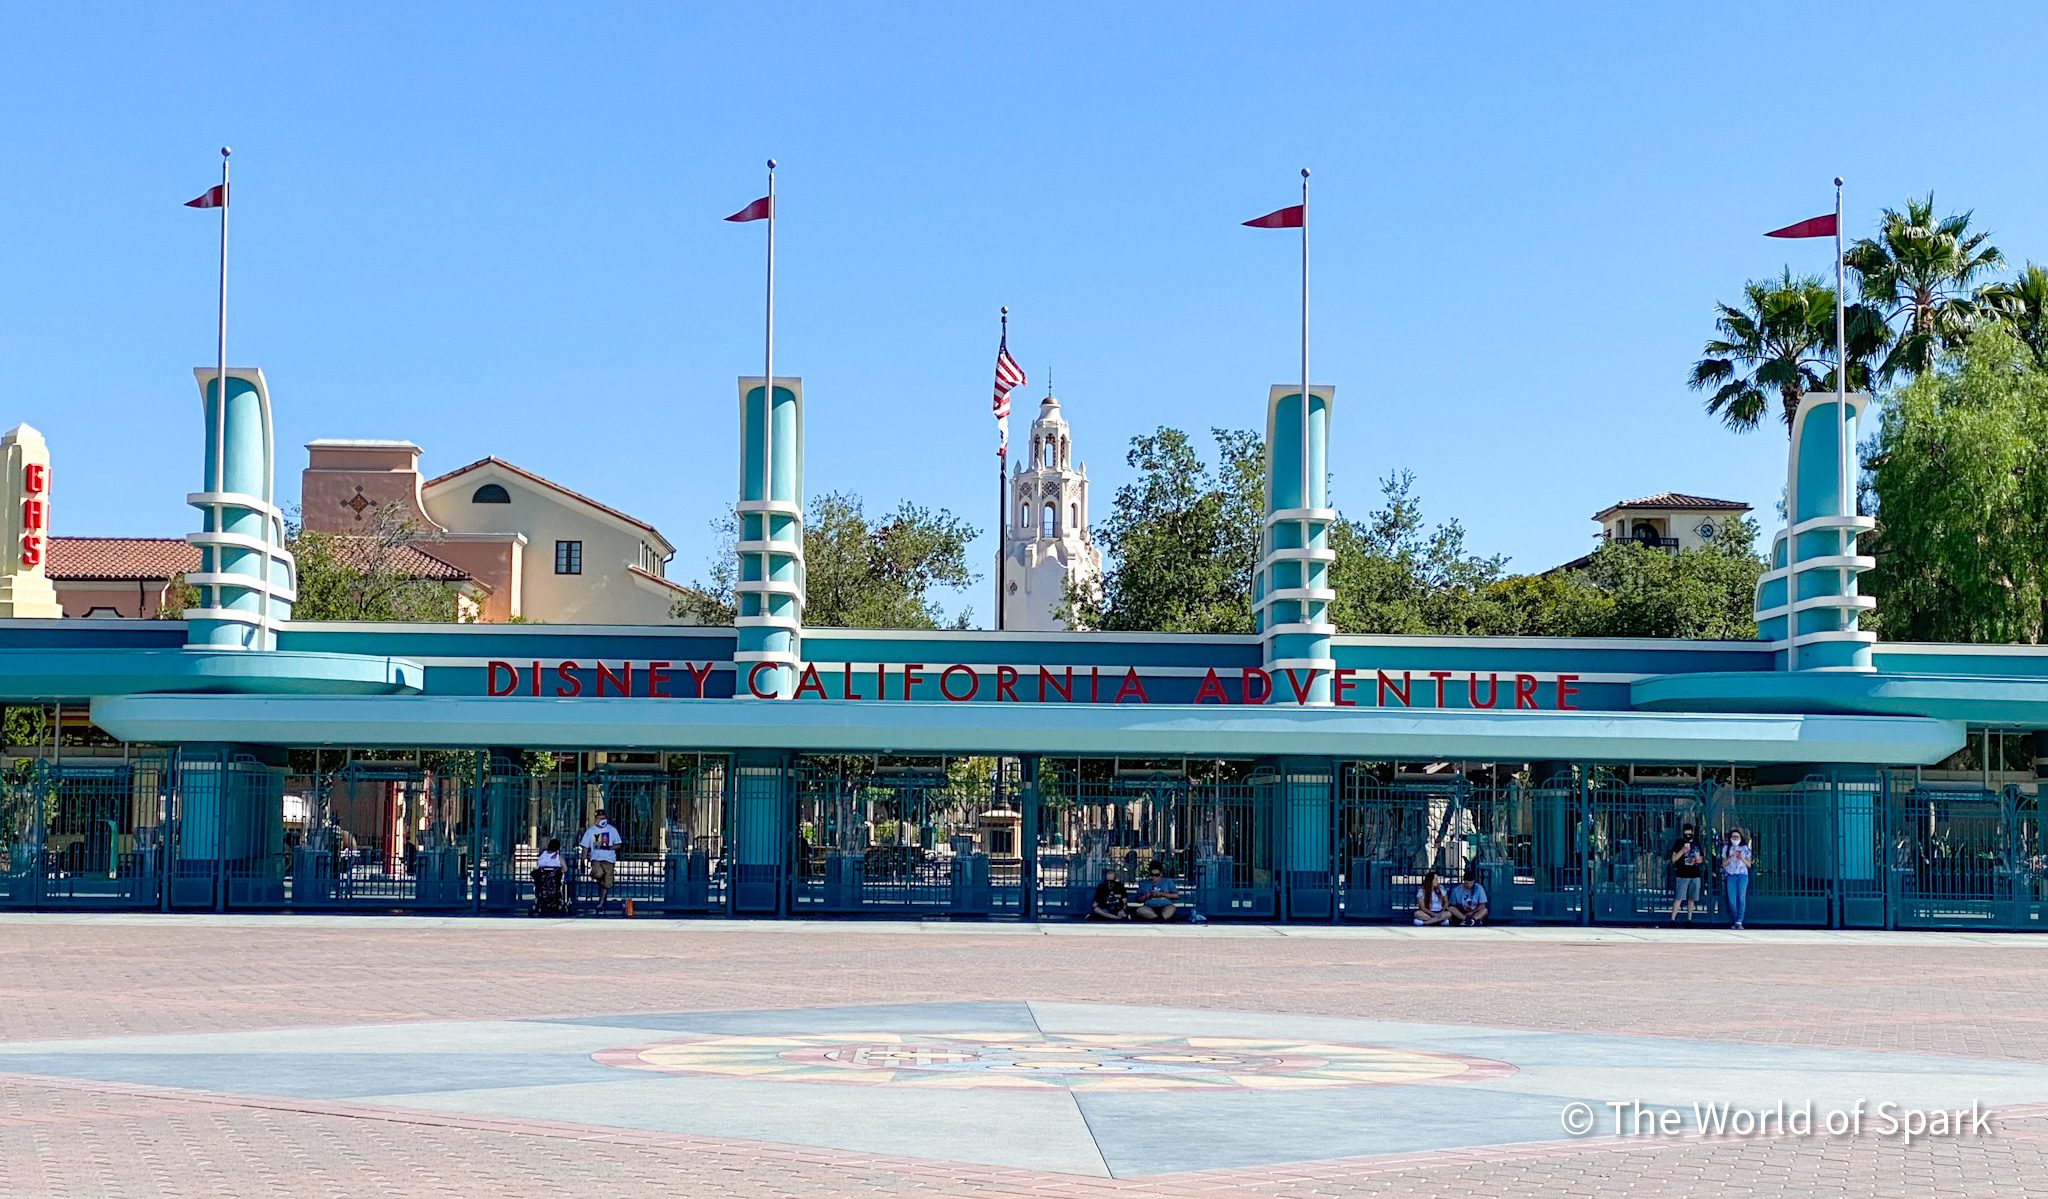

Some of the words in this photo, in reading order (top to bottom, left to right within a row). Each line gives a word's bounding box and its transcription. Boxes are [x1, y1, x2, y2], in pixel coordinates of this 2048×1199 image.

[488, 660, 713, 698] DISNEY
[748, 661, 1148, 704] CALIFORNIA
[1194, 666, 1579, 710] ADVENTURE
